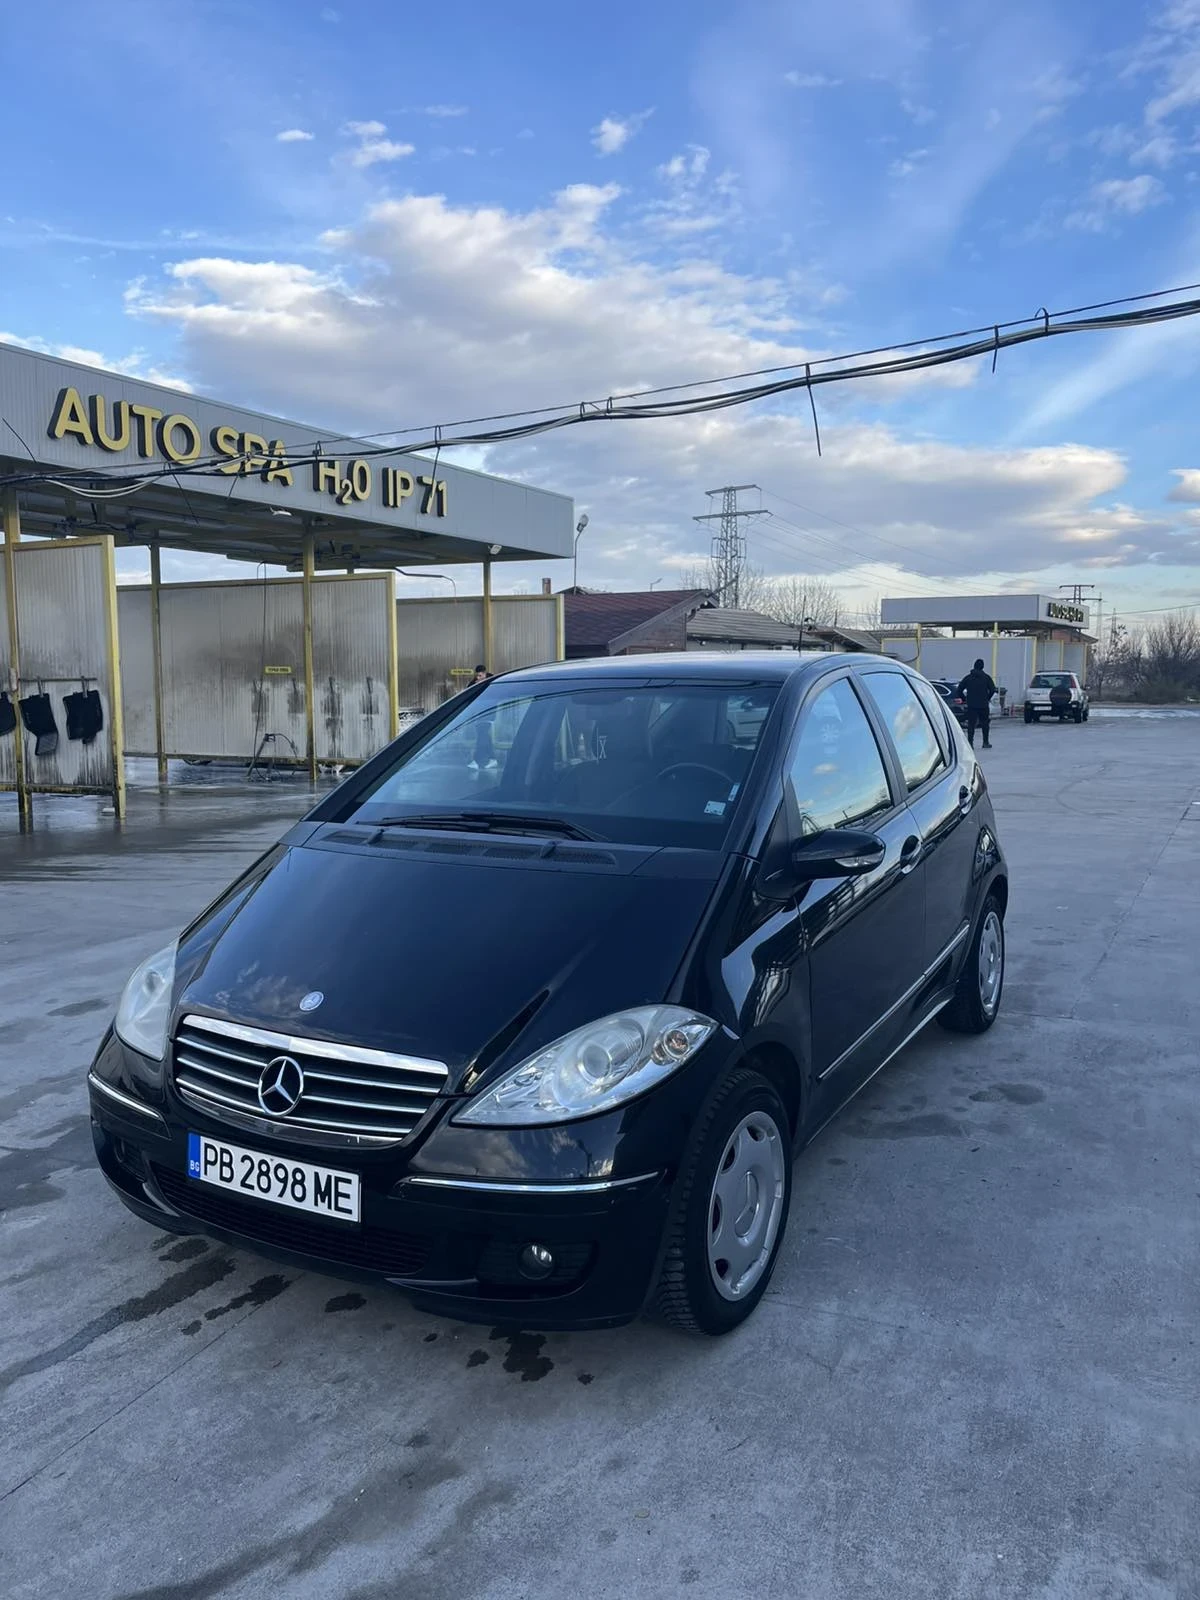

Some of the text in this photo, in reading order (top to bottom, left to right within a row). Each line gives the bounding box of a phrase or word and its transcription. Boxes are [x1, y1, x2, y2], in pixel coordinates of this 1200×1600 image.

[47, 387, 201, 465] AUTO
[210, 426, 294, 486] SPA
[382, 467, 414, 508] IP
[417, 475, 447, 517] 71
[190, 1160, 200, 1172] BG
[204, 1142, 352, 1215] PB 2898 ME
